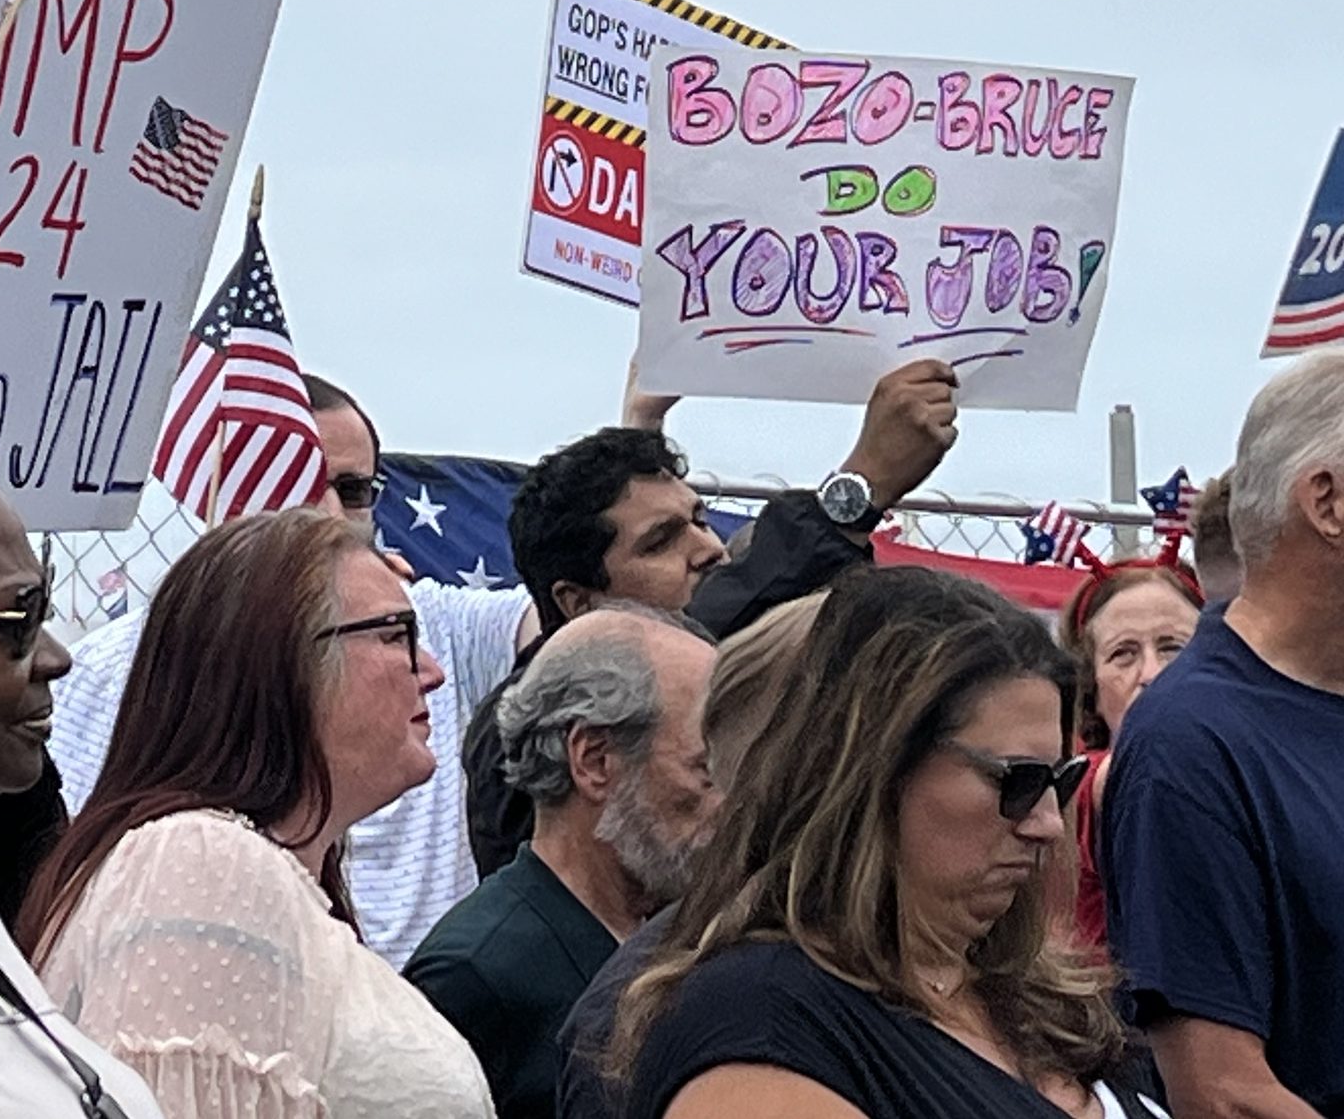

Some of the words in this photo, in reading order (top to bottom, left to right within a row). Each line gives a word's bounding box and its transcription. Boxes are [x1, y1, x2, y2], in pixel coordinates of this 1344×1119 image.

[567, 3, 629, 51] GOP'S
[557, 44, 630, 99] WRONG
[666, 55, 1115, 160] BOZO-BRUCE
[800, 164, 937, 217] DO
[554, 237, 633, 283] NON-WEIRD
[656, 220, 910, 324] YOUR
[925, 225, 1106, 328] JOB!
[10, 293, 162, 494] JAIL
